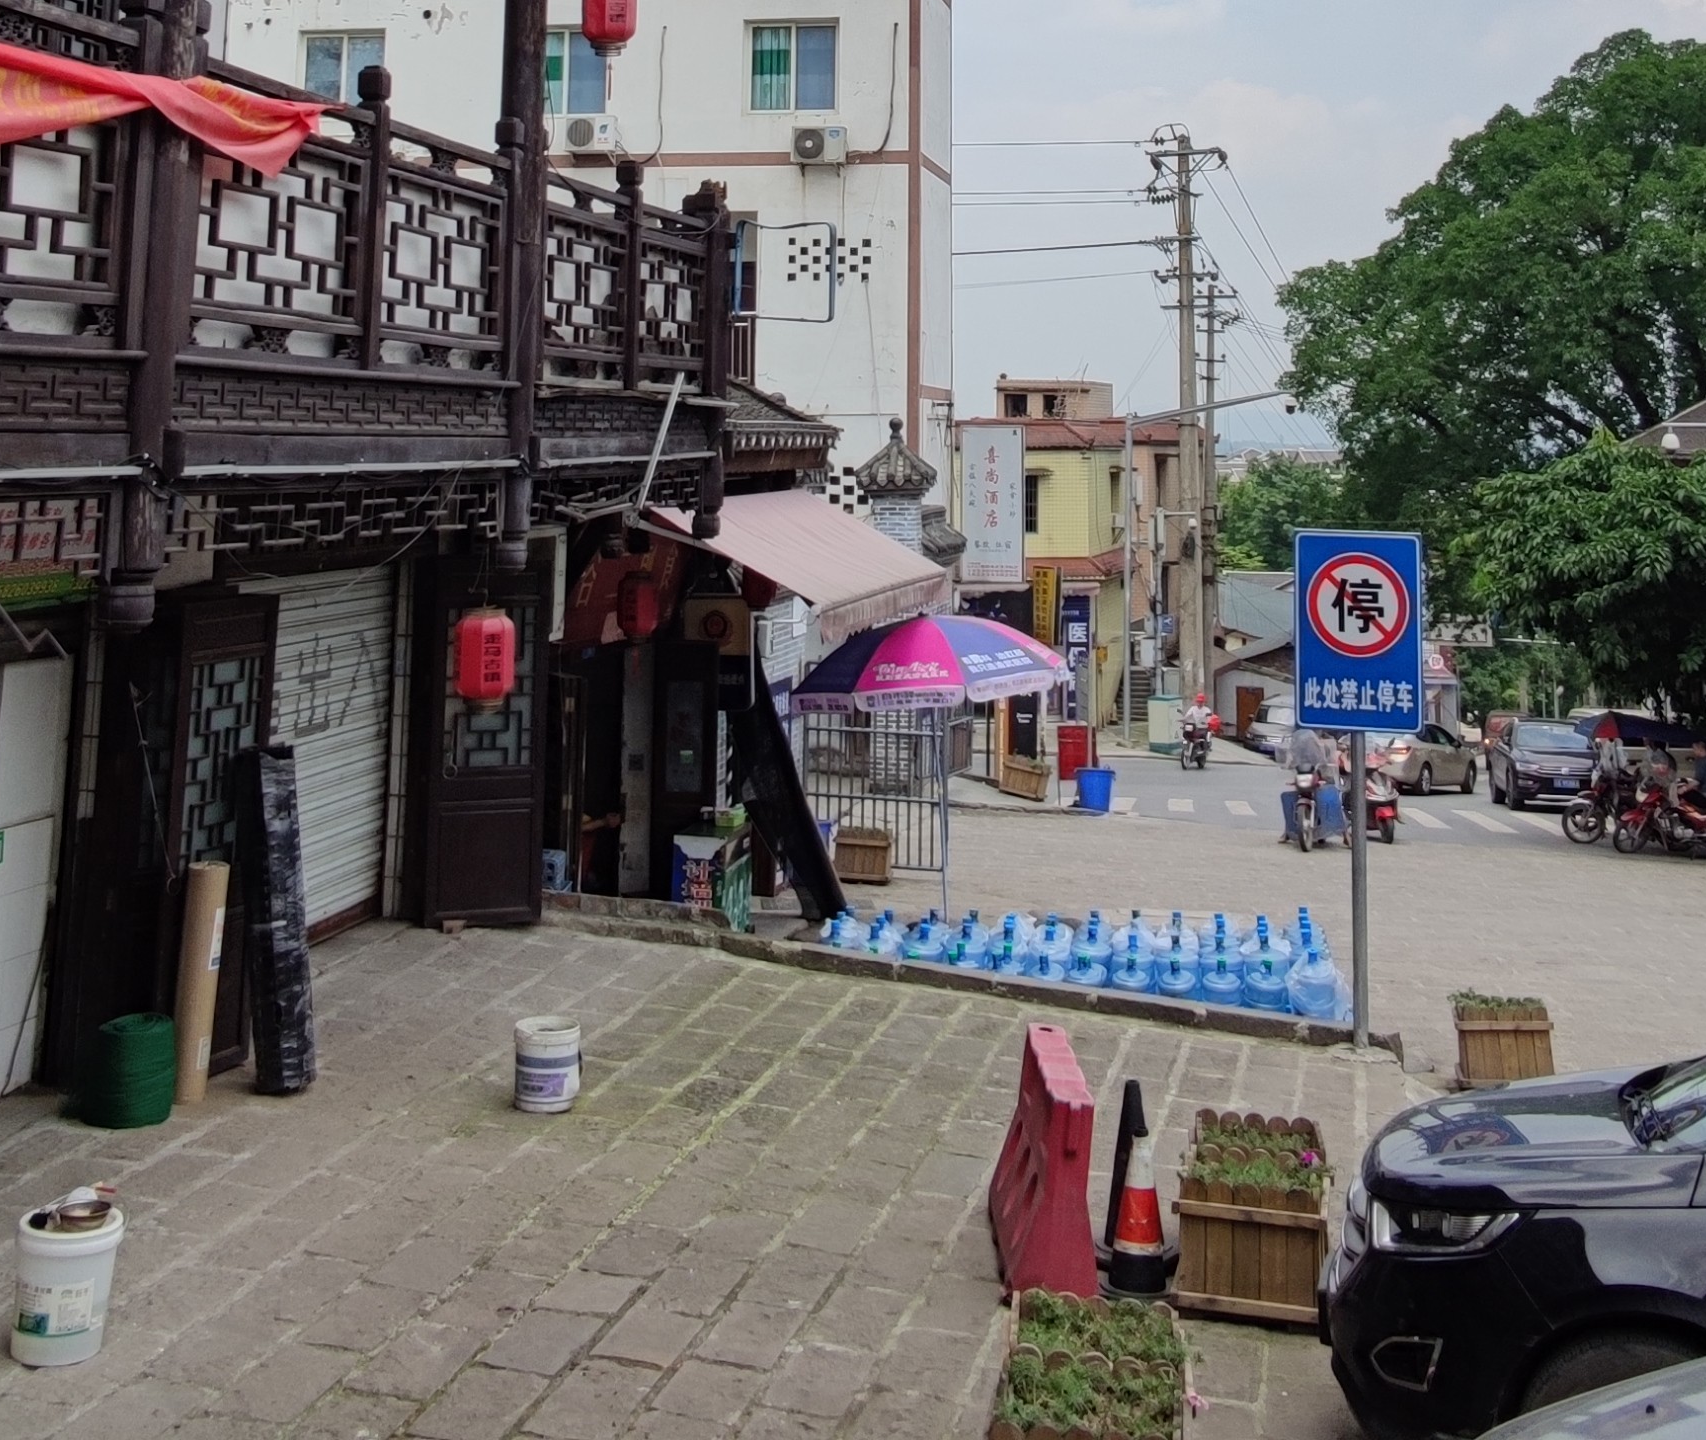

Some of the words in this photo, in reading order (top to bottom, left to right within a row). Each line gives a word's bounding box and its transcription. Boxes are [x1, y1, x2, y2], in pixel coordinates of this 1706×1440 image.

[984, 445, 1000, 528] 喜尚酒店
[1331, 578, 1385, 634] 停
[1304, 677, 1414, 714] 此处禁止停车
